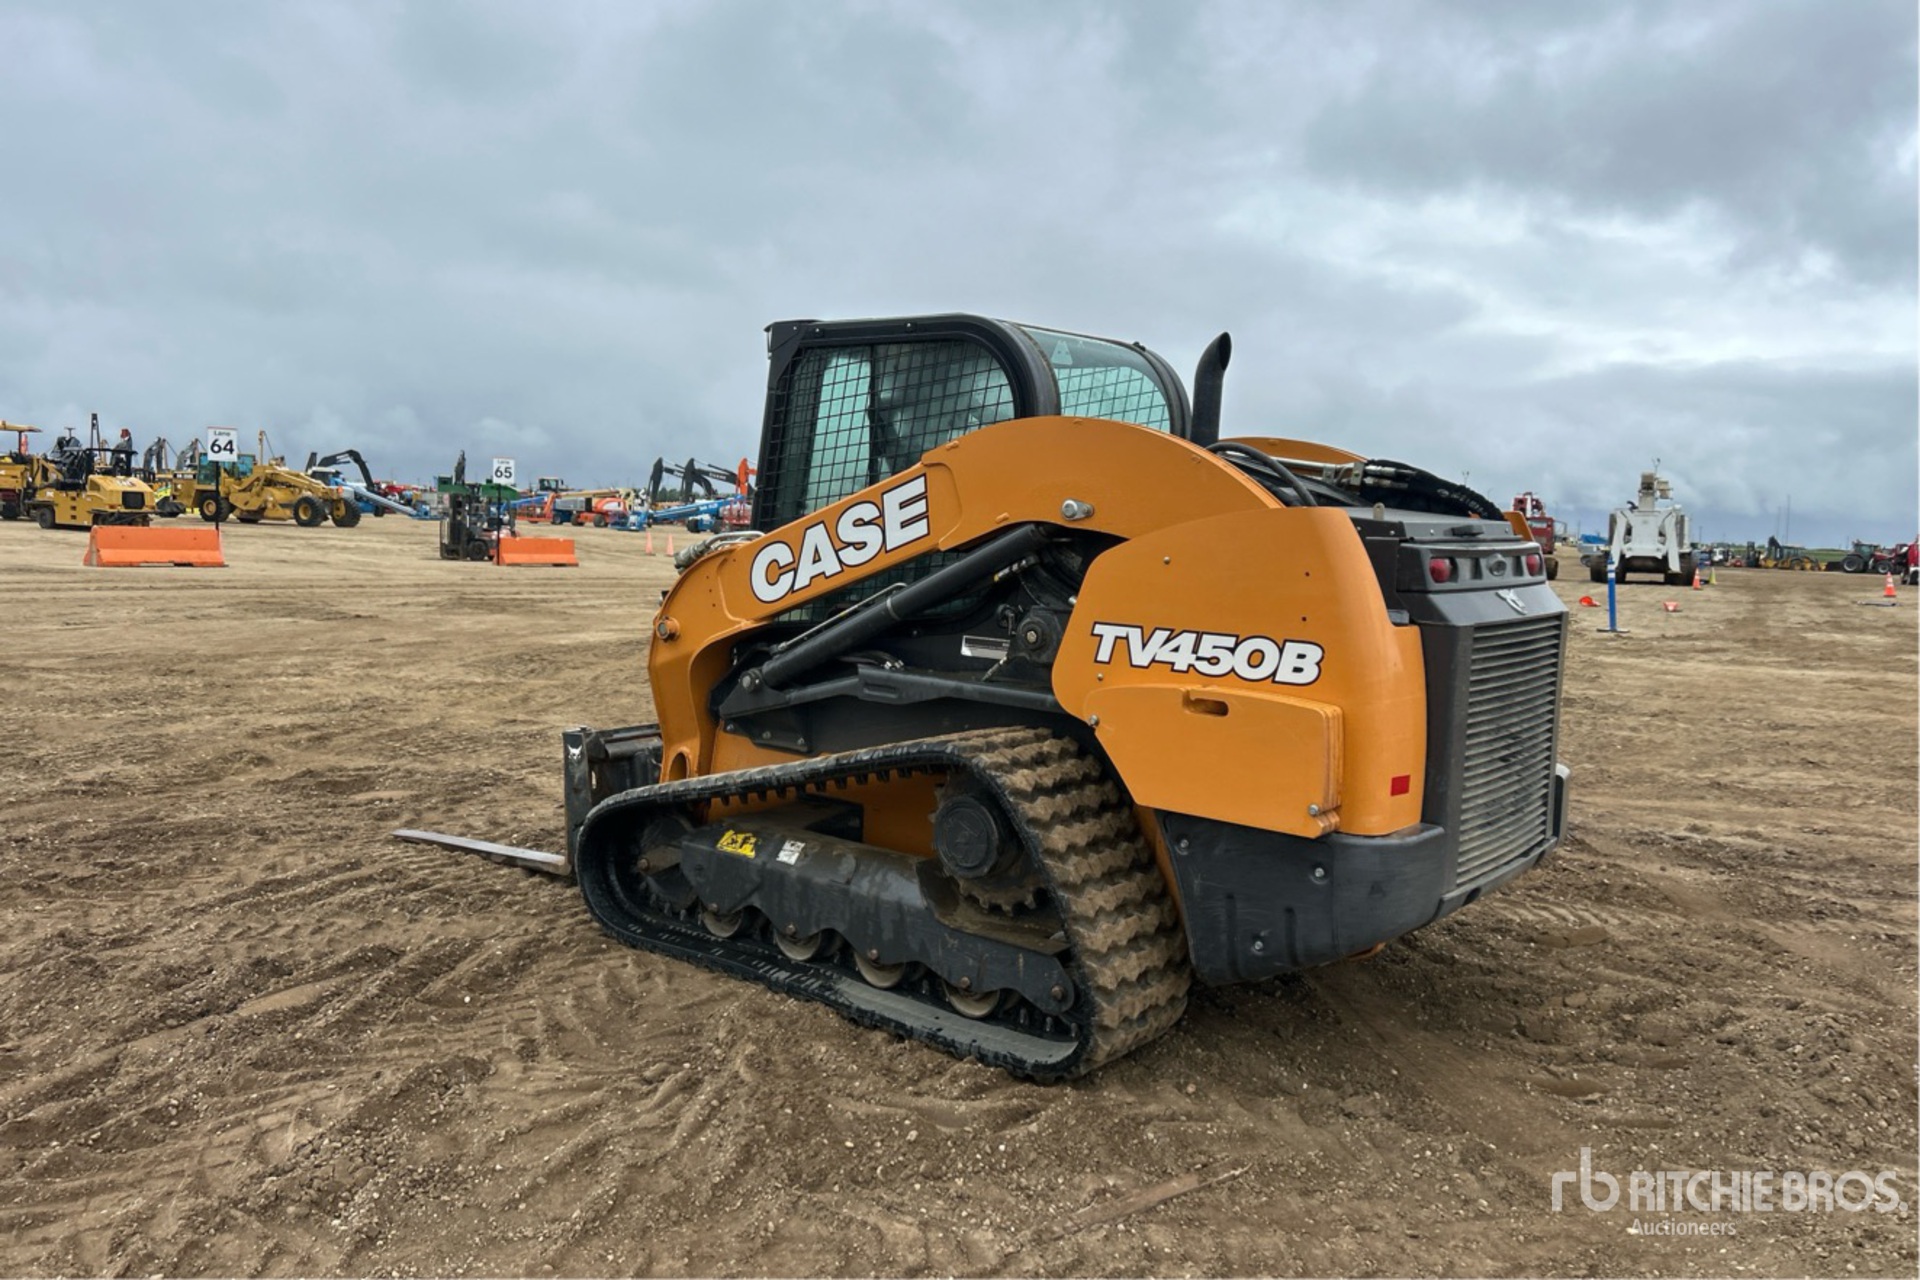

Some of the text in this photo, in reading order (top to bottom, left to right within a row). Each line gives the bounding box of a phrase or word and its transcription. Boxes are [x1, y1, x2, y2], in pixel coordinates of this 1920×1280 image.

[210, 438, 235, 455] 64
[494, 466, 512, 479] 65
[750, 473, 930, 603] CASE
[1091, 621, 1325, 686] TV450B
